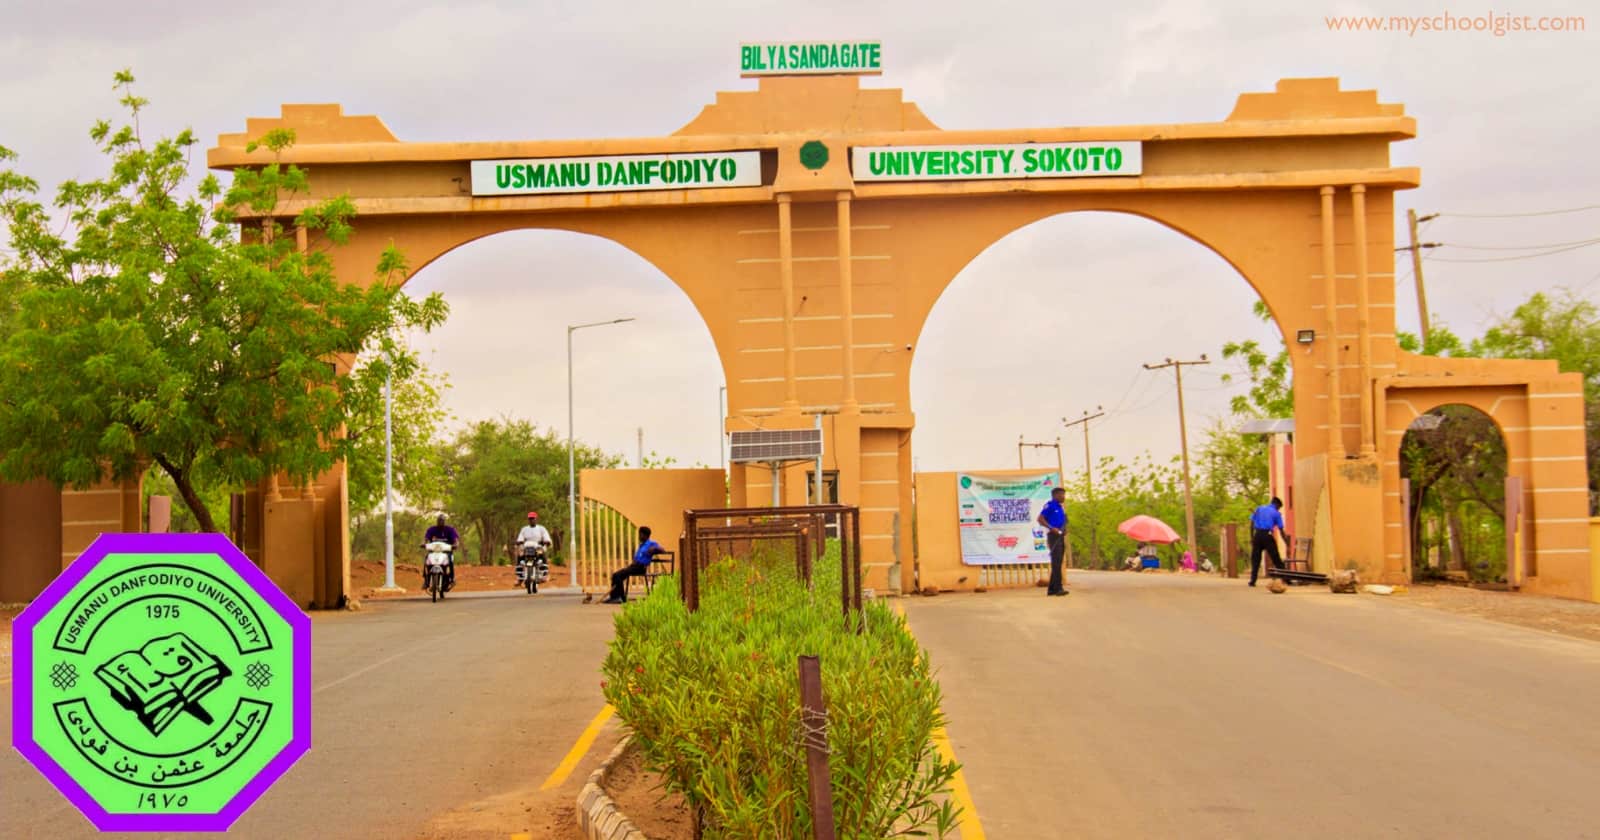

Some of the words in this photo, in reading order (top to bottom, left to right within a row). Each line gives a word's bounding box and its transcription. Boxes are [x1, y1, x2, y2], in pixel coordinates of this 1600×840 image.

[496, 163, 591, 189] USMANU
[597, 158, 737, 186] DANFODIYO
[1022, 146, 1124, 173] SOKOTO
